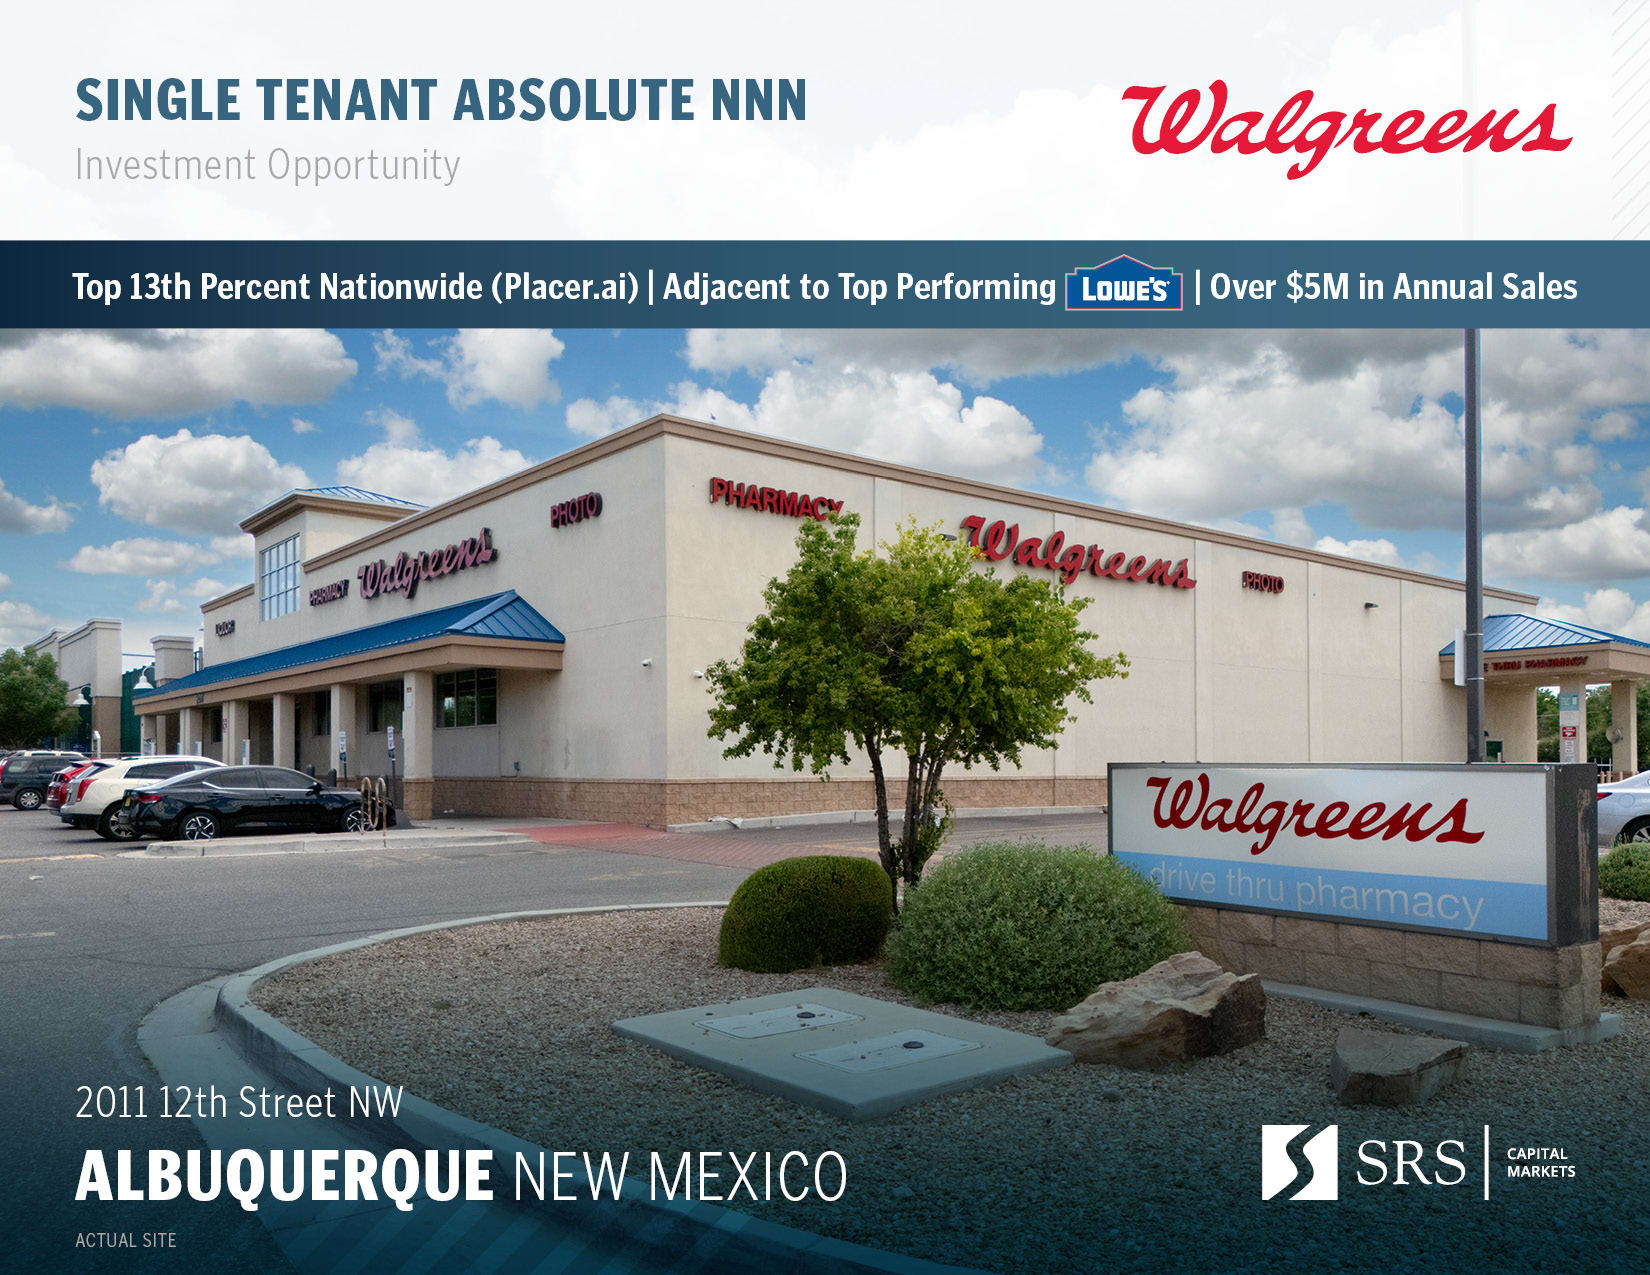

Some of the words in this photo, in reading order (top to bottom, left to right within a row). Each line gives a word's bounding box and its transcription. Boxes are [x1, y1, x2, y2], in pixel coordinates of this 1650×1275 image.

[551, 492, 602, 528] PHOTO
[709, 477, 844, 521] PHARMACY
[357, 527, 498, 600] Walgreens
[960, 514, 1197, 589] Walgreens
[309, 579, 349, 606] PHARMACY
[1242, 571, 1284, 594] PHOTO
[1525, 656, 1588, 668] PHARMACY
[1146, 773, 1485, 856] Walgreens
[1151, 861, 1216, 894] drive
[1227, 868, 1284, 901] thru
[1297, 875, 1484, 931] pharmacy
